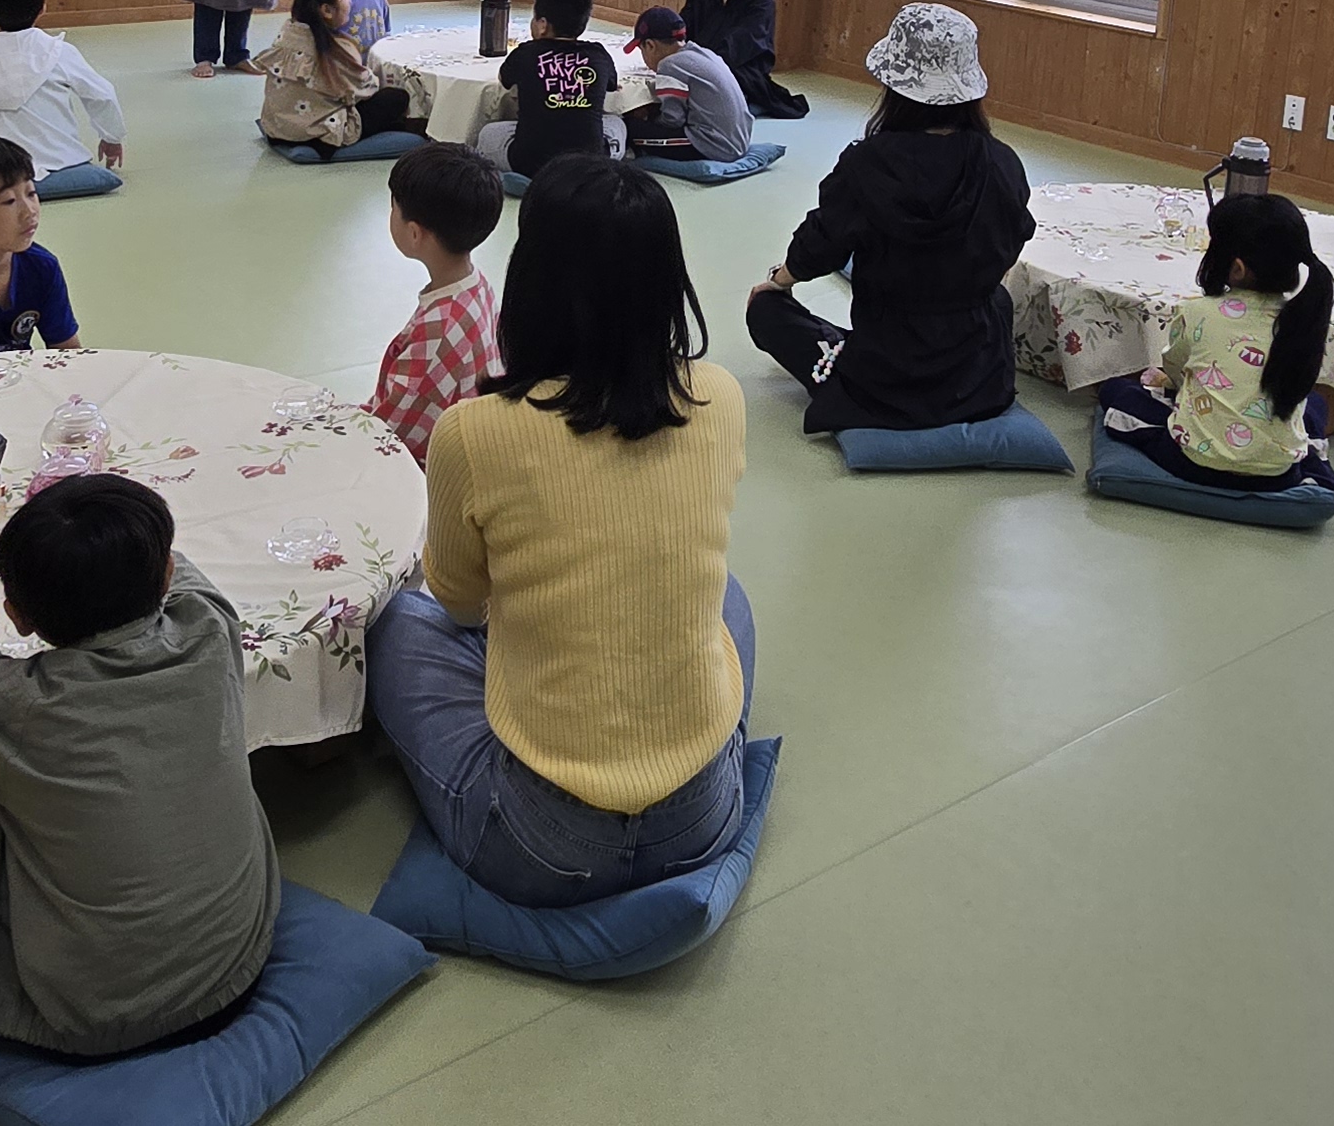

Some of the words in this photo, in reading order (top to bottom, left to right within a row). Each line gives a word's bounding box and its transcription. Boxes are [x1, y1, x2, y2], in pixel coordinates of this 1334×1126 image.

[538, 50, 589, 78] FEEL
[549, 62, 575, 81] MY
[544, 93, 592, 109] Smile
